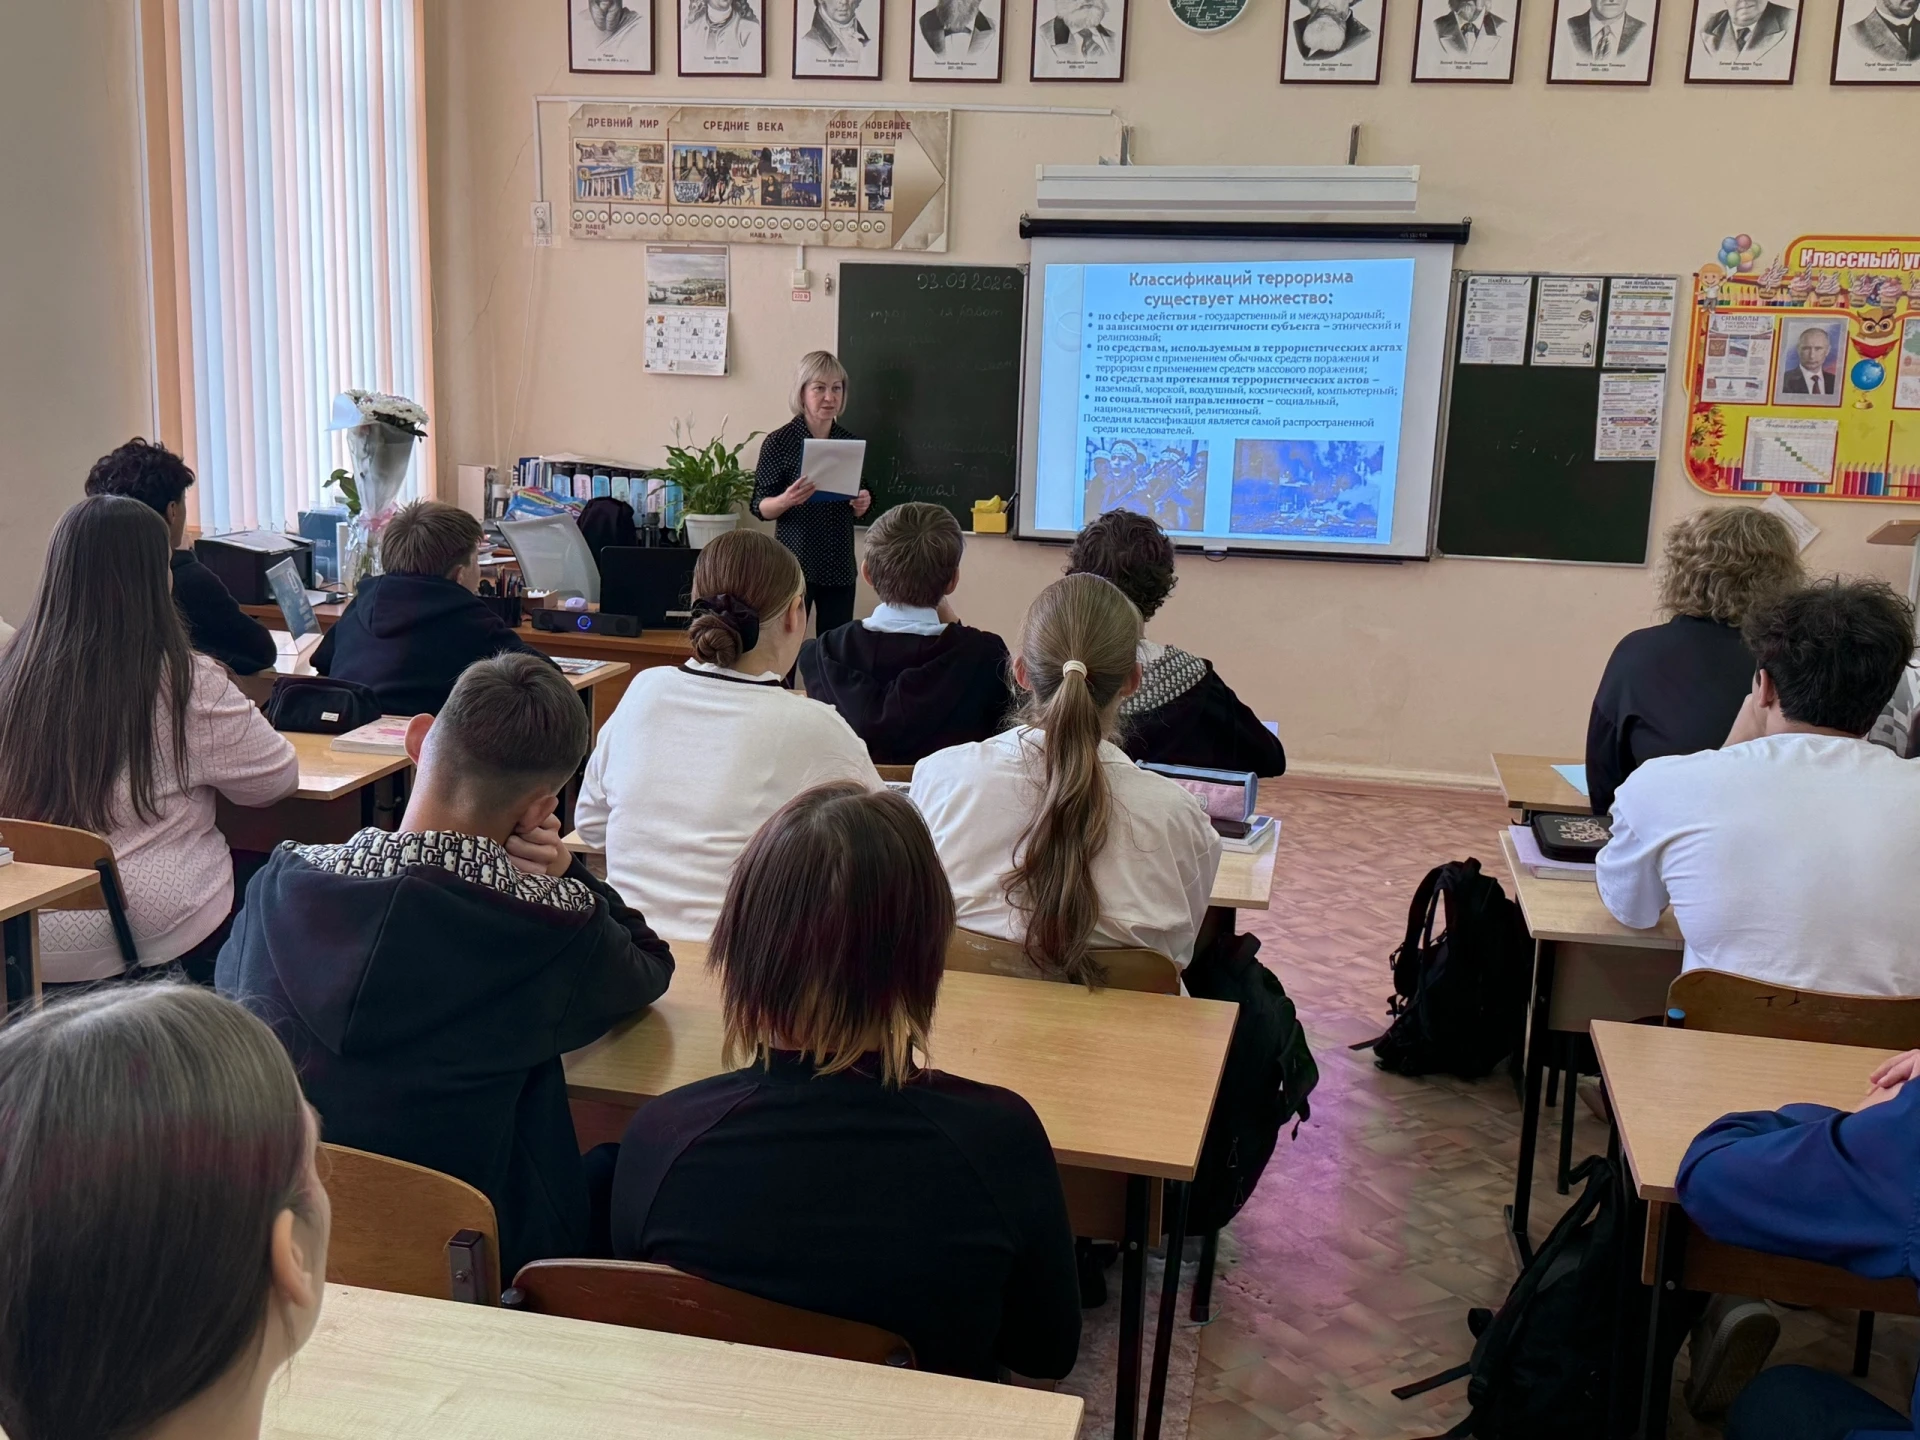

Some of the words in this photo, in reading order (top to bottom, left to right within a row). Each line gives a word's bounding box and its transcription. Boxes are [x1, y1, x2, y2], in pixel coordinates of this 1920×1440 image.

[1219, 8, 1225, 17] 5
[586, 117, 633, 129] ДРЕВНИЙ
[640, 118, 660, 129] МИР
[703, 120, 750, 132] СРЕДНИЕ
[756, 121, 784, 132] ВЕКА
[829, 120, 858, 130] НОВОЕ
[865, 120, 912, 131] НОВЕЙШЕЕ
[829, 130, 858, 140] ВРЕМЯ
[874, 130, 903, 140] ВРЕМЯ
[1800, 248, 1901, 268] Классный
[1129, 270, 1252, 289] Классификаций
[1257, 272, 1354, 287] терроризма
[1144, 294, 1233, 309] существует
[1238, 293, 1333, 305] множество:
[1113, 312, 1145, 322] сфере
[1146, 312, 1196, 321] действия
[1204, 311, 1287, 321] государственный
[1298, 310, 1386, 321] международный;
[1190, 323, 1268, 332] идентичности
[1270, 322, 1320, 332] субъекта
[1332, 321, 1391, 330] этнический
[1097, 334, 1161, 343] религиозный;
[1111, 344, 1168, 353] средствам,
[1170, 344, 1251, 354] используемым
[1262, 344, 1368, 354] террористических
[1104, 356, 1153, 364] терроризм
[1162, 356, 1226, 364] применением
[1228, 354, 1272, 362] обычных
[1275, 356, 1312, 364] средств
[1314, 355, 1370, 364] поражения
[1095, 366, 1144, 374] терроризм
[1153, 366, 1217, 374] применением
[1219, 366, 1255, 374] средств
[1308, 366, 1367, 375] поражения;
[1110, 375, 1163, 384] средствам
[1166, 376, 1229, 384] протекания
[1231, 376, 1335, 385] террористических
[1095, 385, 1144, 394] наземный,
[1145, 386, 1187, 395] морской,
[1189, 386, 1246, 395] воздушный,
[1248, 386, 1314, 395] космический,
[1317, 386, 1398, 396] компьютерный;
[1109, 394, 1172, 404] социальной
[1174, 397, 1264, 406] направленности
[1275, 397, 1338, 407] социальный,
[1094, 405, 1193, 415] националистический,
[1195, 407, 1261, 416] религиозный.
[1083, 414, 1132, 424] Последняя
[1134, 416, 1205, 426] классификация
[1251, 417, 1281, 426] самой
[1283, 418, 1374, 428] распространенной
[1093, 426, 1118, 434] среди
[1121, 426, 1195, 435] исследователей.
